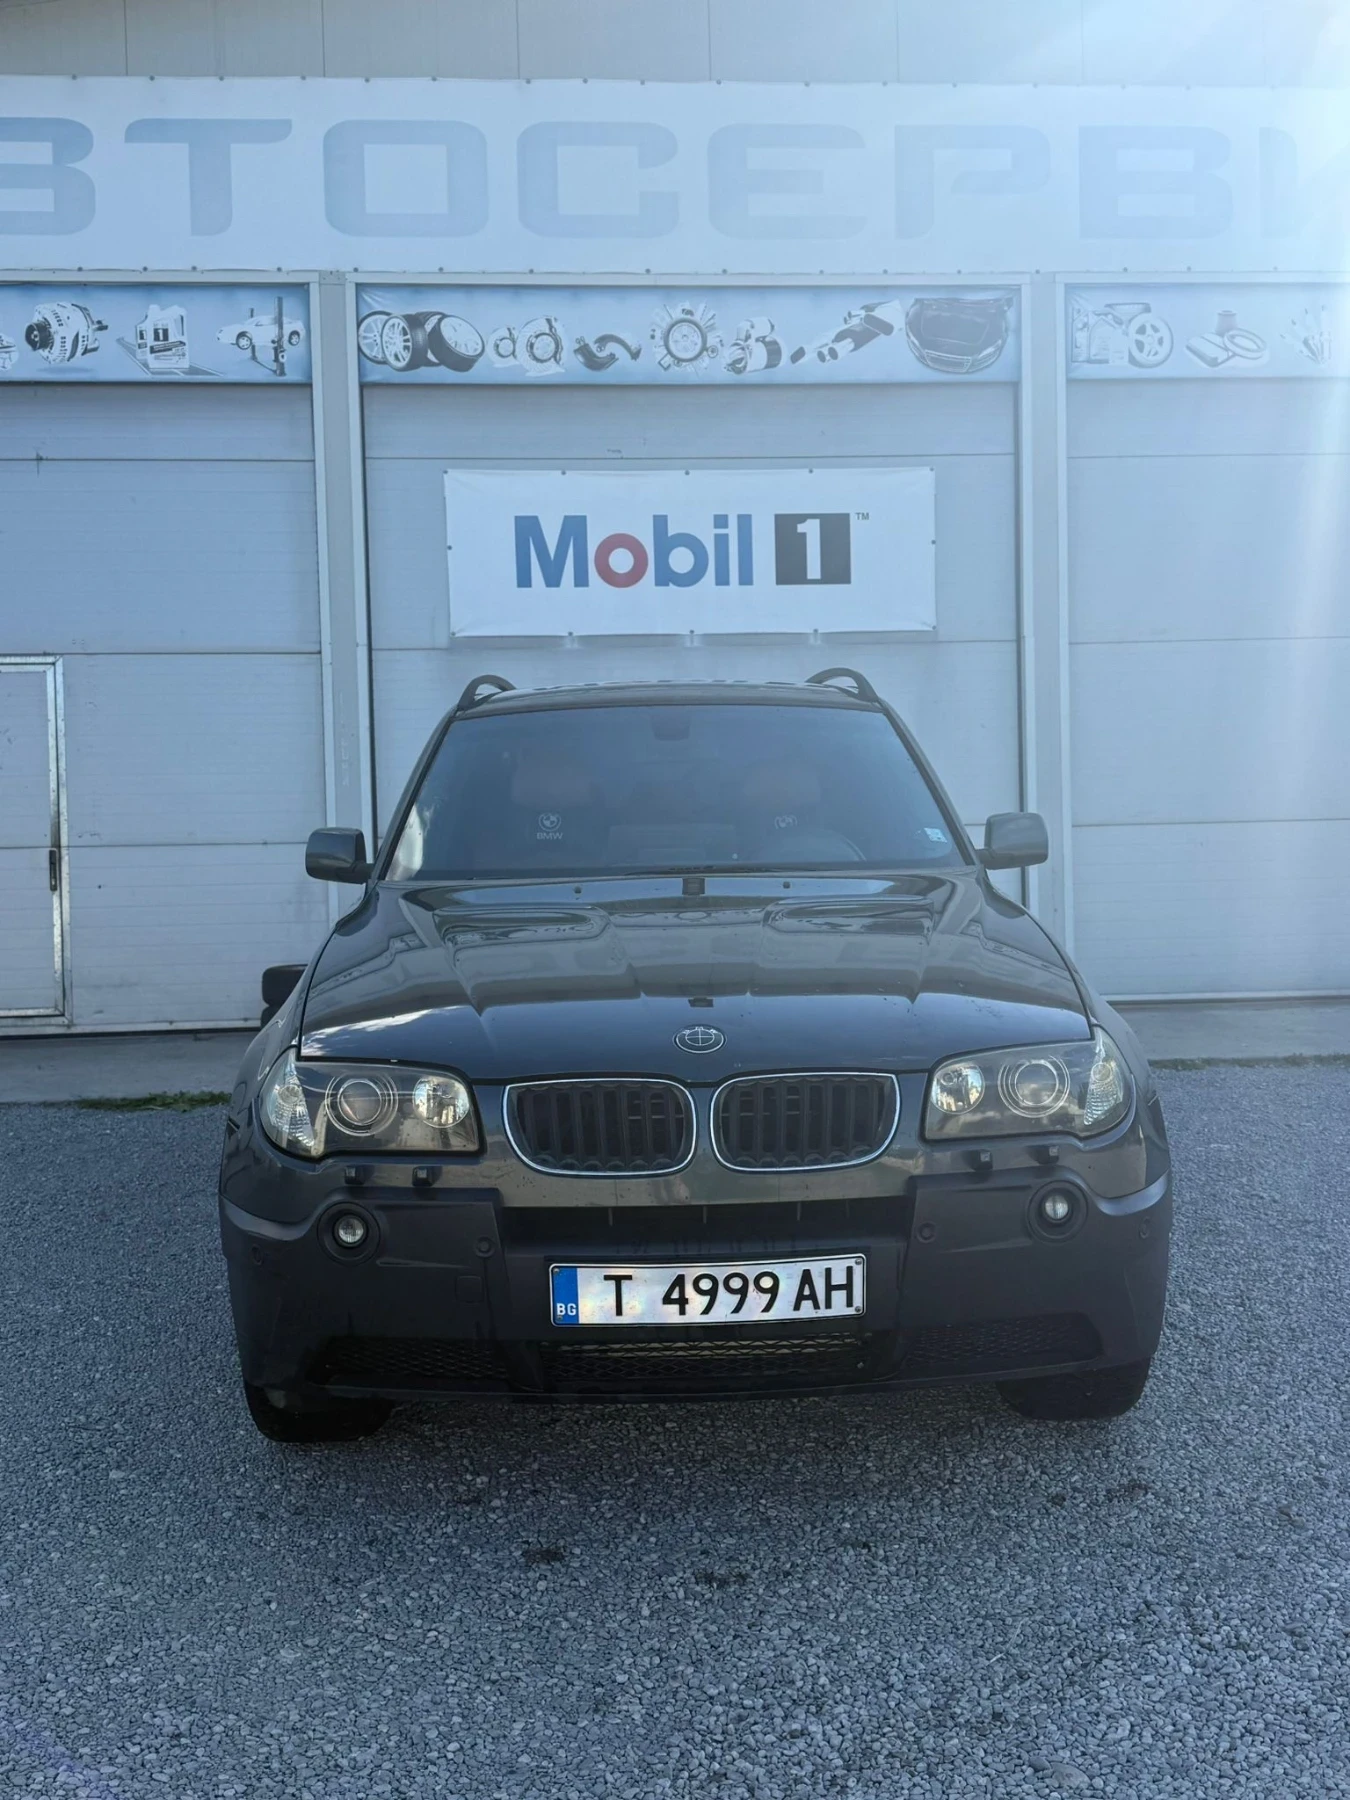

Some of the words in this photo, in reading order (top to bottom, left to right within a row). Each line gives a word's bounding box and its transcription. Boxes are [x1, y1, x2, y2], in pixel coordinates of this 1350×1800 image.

[514, 513, 754, 588] Mobil
[536, 832, 564, 840] BMW
[556, 1303, 577, 1316] BG
[603, 1274, 633, 1317] T
[662, 1271, 780, 1316] 4999
[793, 1265, 854, 1312] AH
